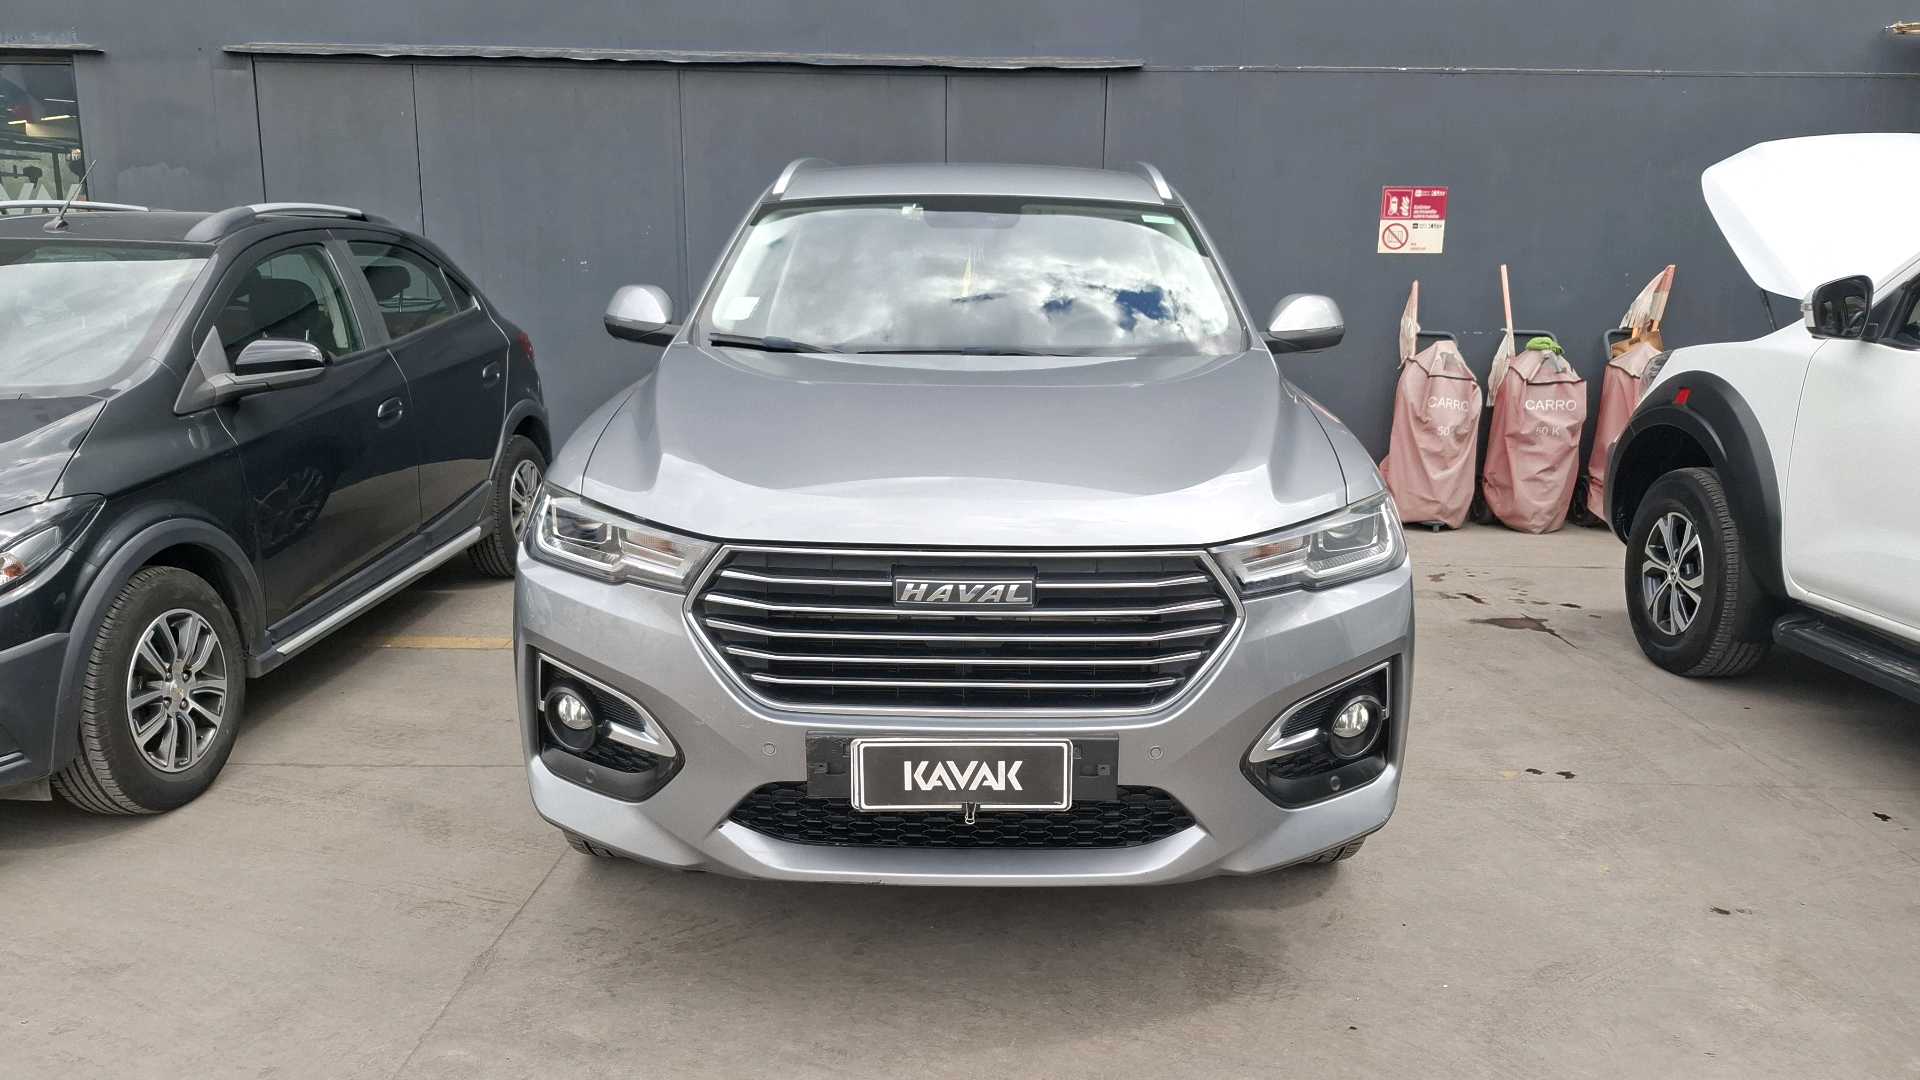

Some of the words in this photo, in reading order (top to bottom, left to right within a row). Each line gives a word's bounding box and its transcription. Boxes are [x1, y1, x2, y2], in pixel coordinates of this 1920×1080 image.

[1525, 399, 1577, 411] CARRO
[900, 583, 1029, 602] HAVAL
[903, 760, 1023, 791] KAVAK
